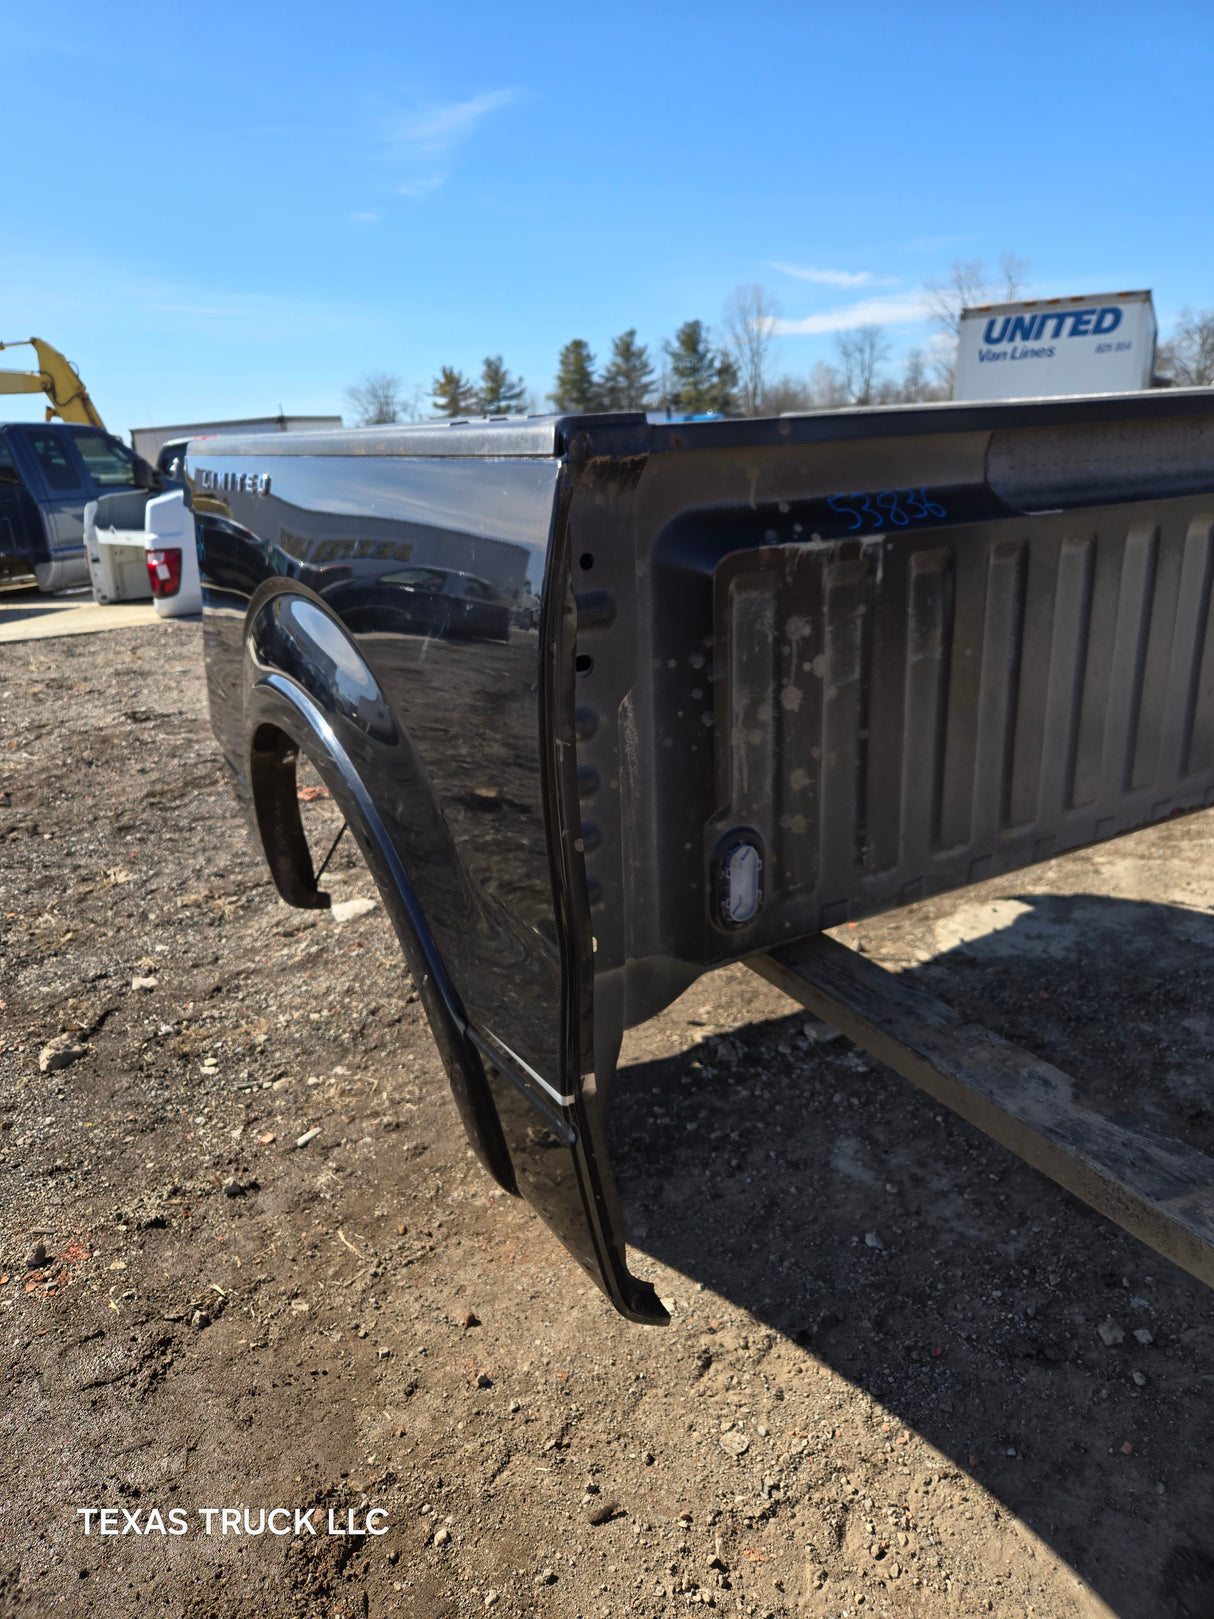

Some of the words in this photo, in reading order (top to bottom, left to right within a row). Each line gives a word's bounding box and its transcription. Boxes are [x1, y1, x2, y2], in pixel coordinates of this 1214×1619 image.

[983, 306, 1122, 345] UNITED
[978, 348, 1008, 363] Van
[1010, 344, 1056, 360] Lines
[826, 487, 947, 530] 53836
